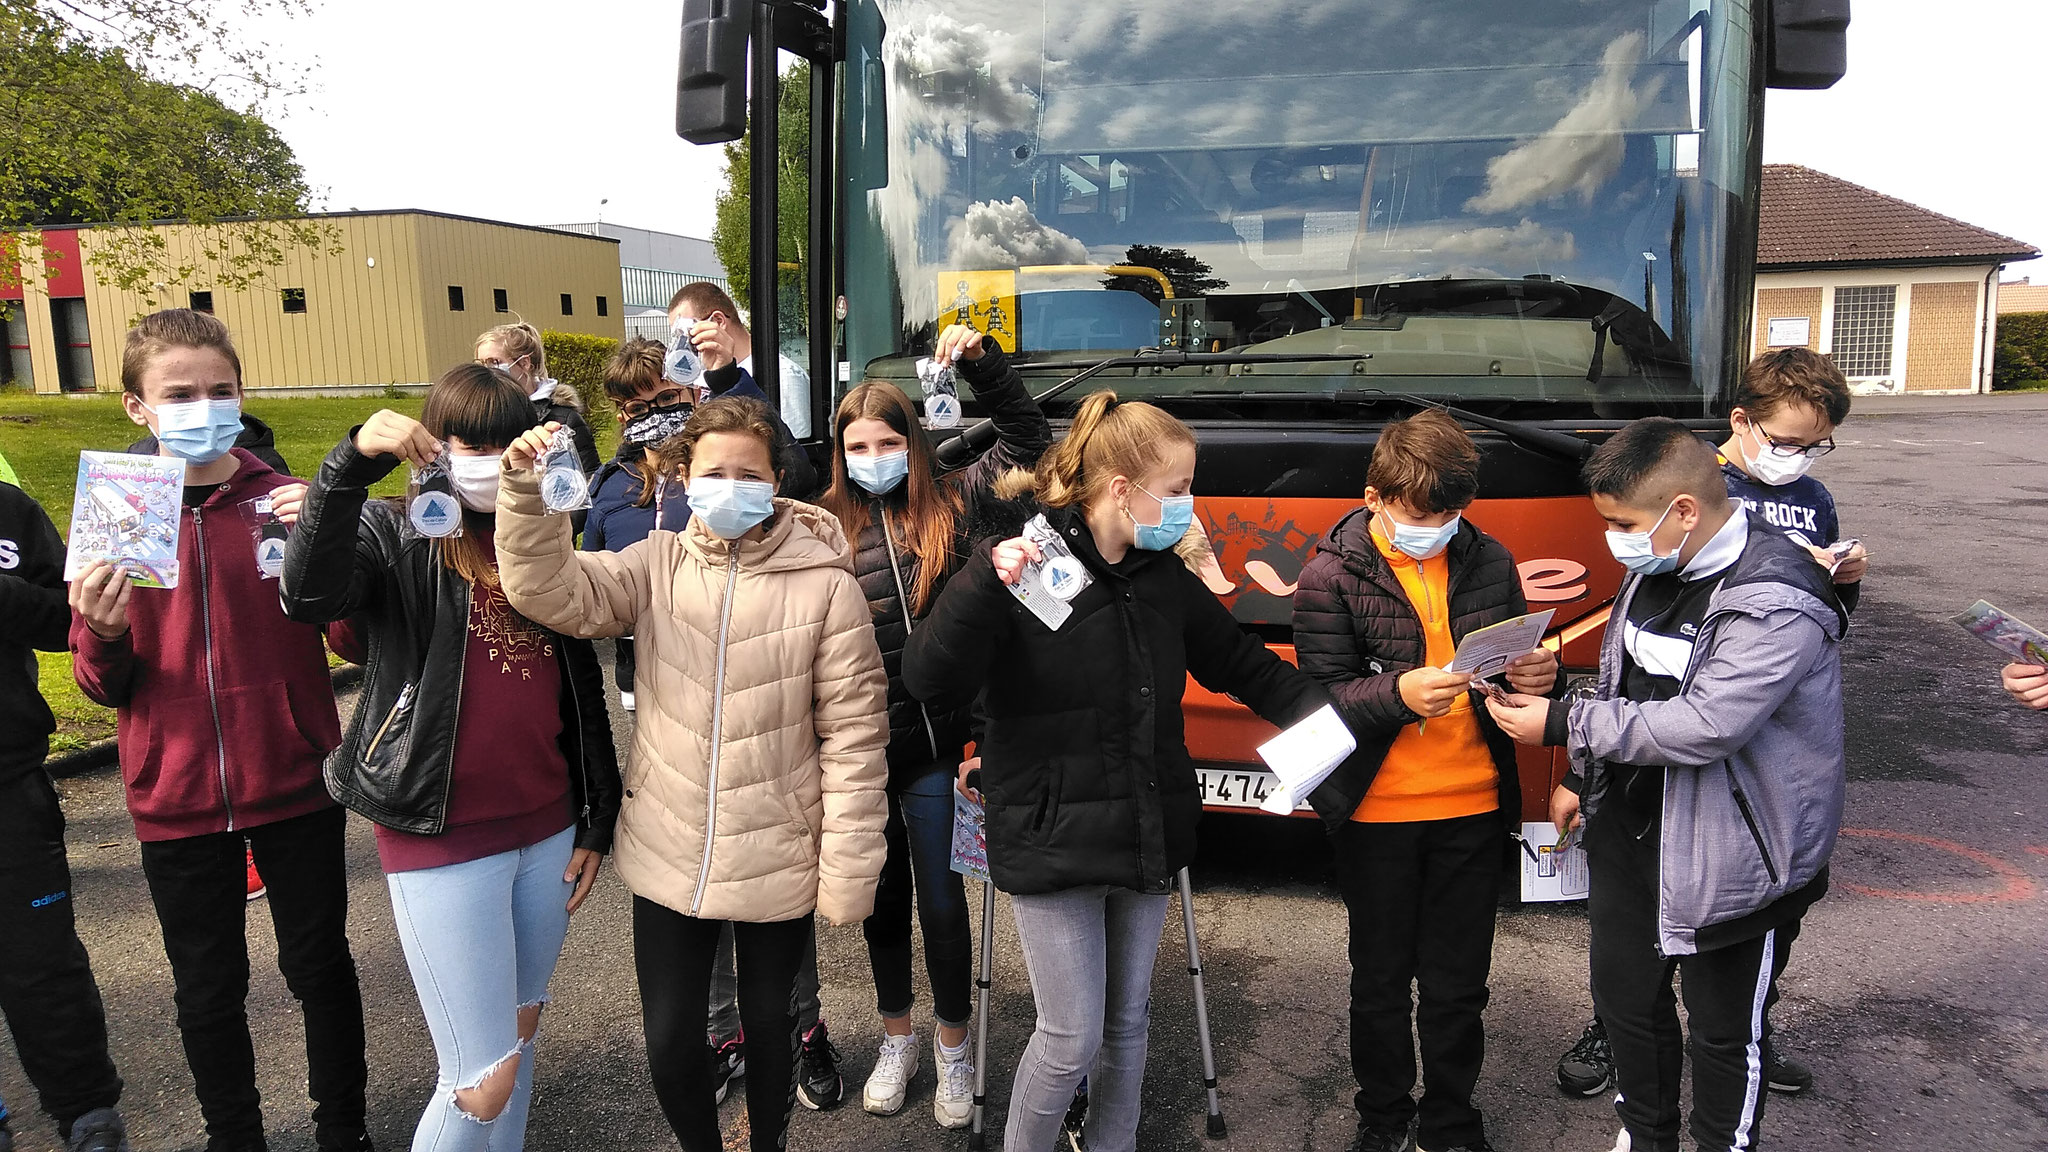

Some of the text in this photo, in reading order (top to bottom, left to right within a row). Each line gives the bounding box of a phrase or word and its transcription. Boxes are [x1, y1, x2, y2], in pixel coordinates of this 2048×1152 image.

[1763, 501, 1818, 532] ROCK
[0, 538, 20, 570] S
[31, 890, 67, 908] adidas
